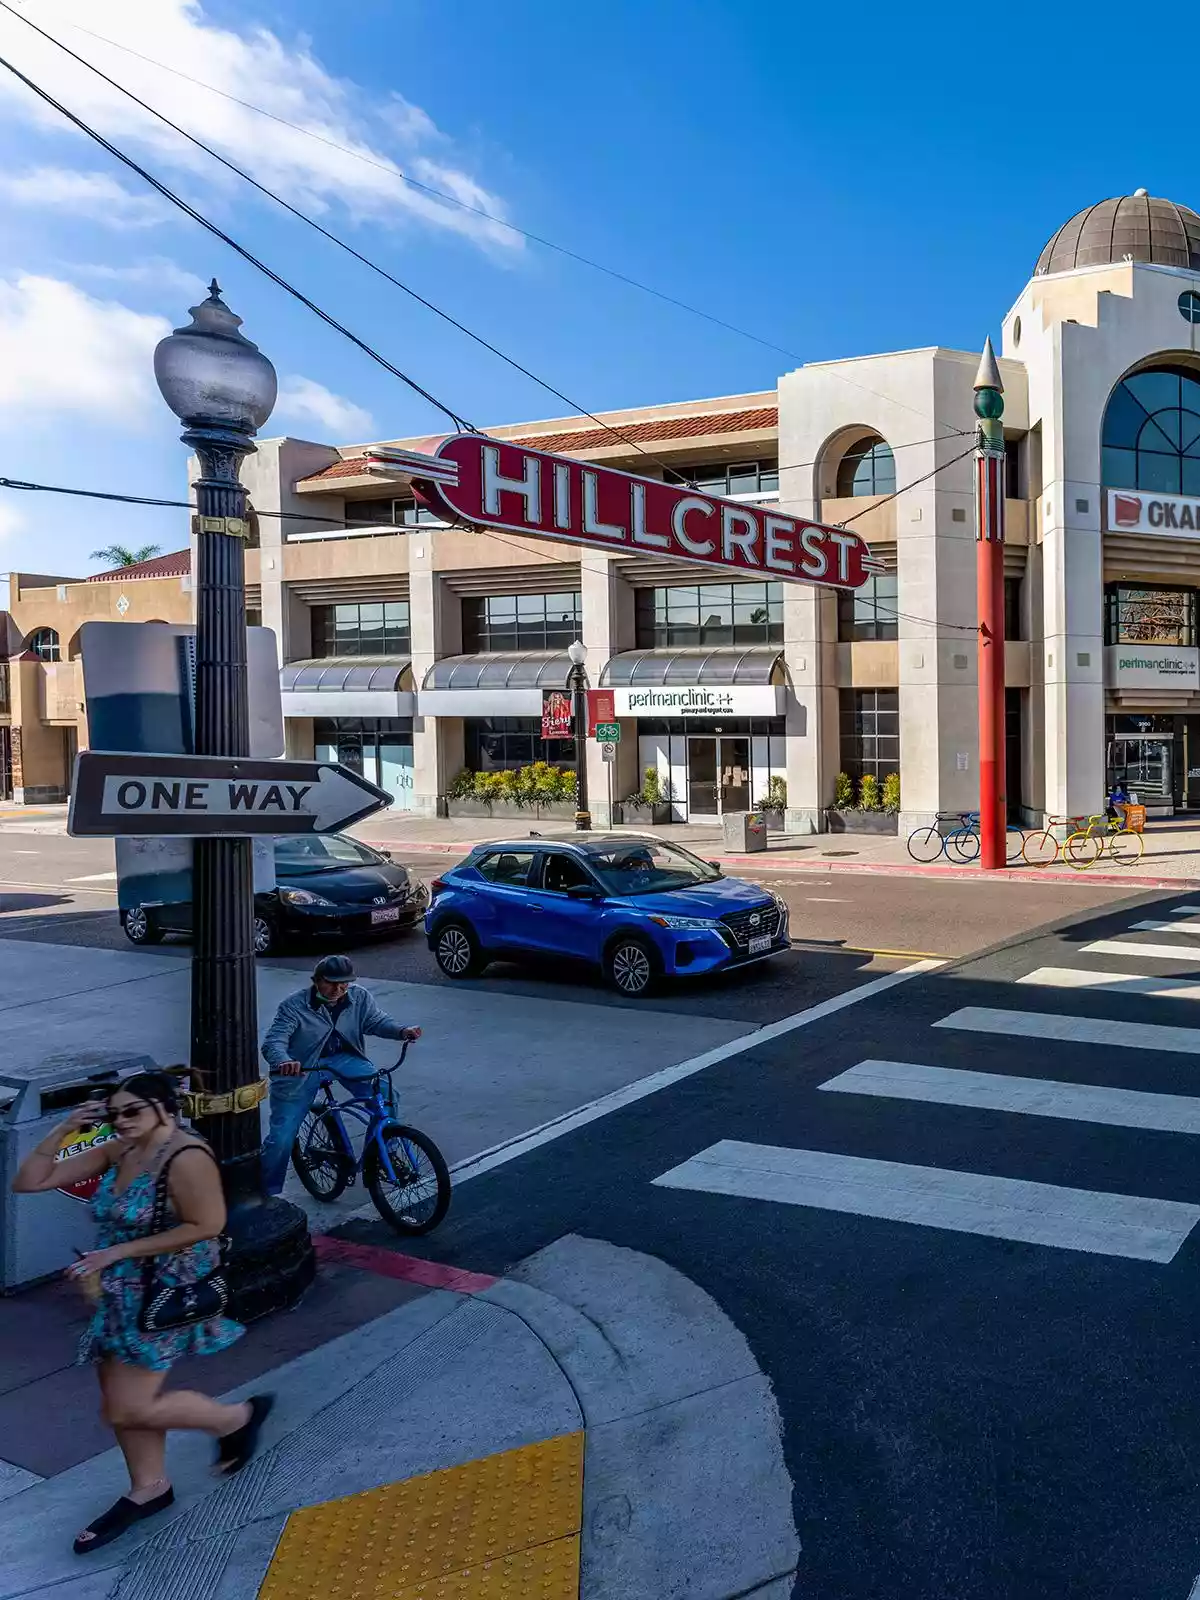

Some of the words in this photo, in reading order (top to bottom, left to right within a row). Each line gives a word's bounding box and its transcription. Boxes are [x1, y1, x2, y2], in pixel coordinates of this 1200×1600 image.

[480, 445, 859, 583] HILLCREST
[628, 689, 715, 710] perlmanclinic
[117, 781, 209, 810] ONE
[228, 784, 311, 810] WAY
